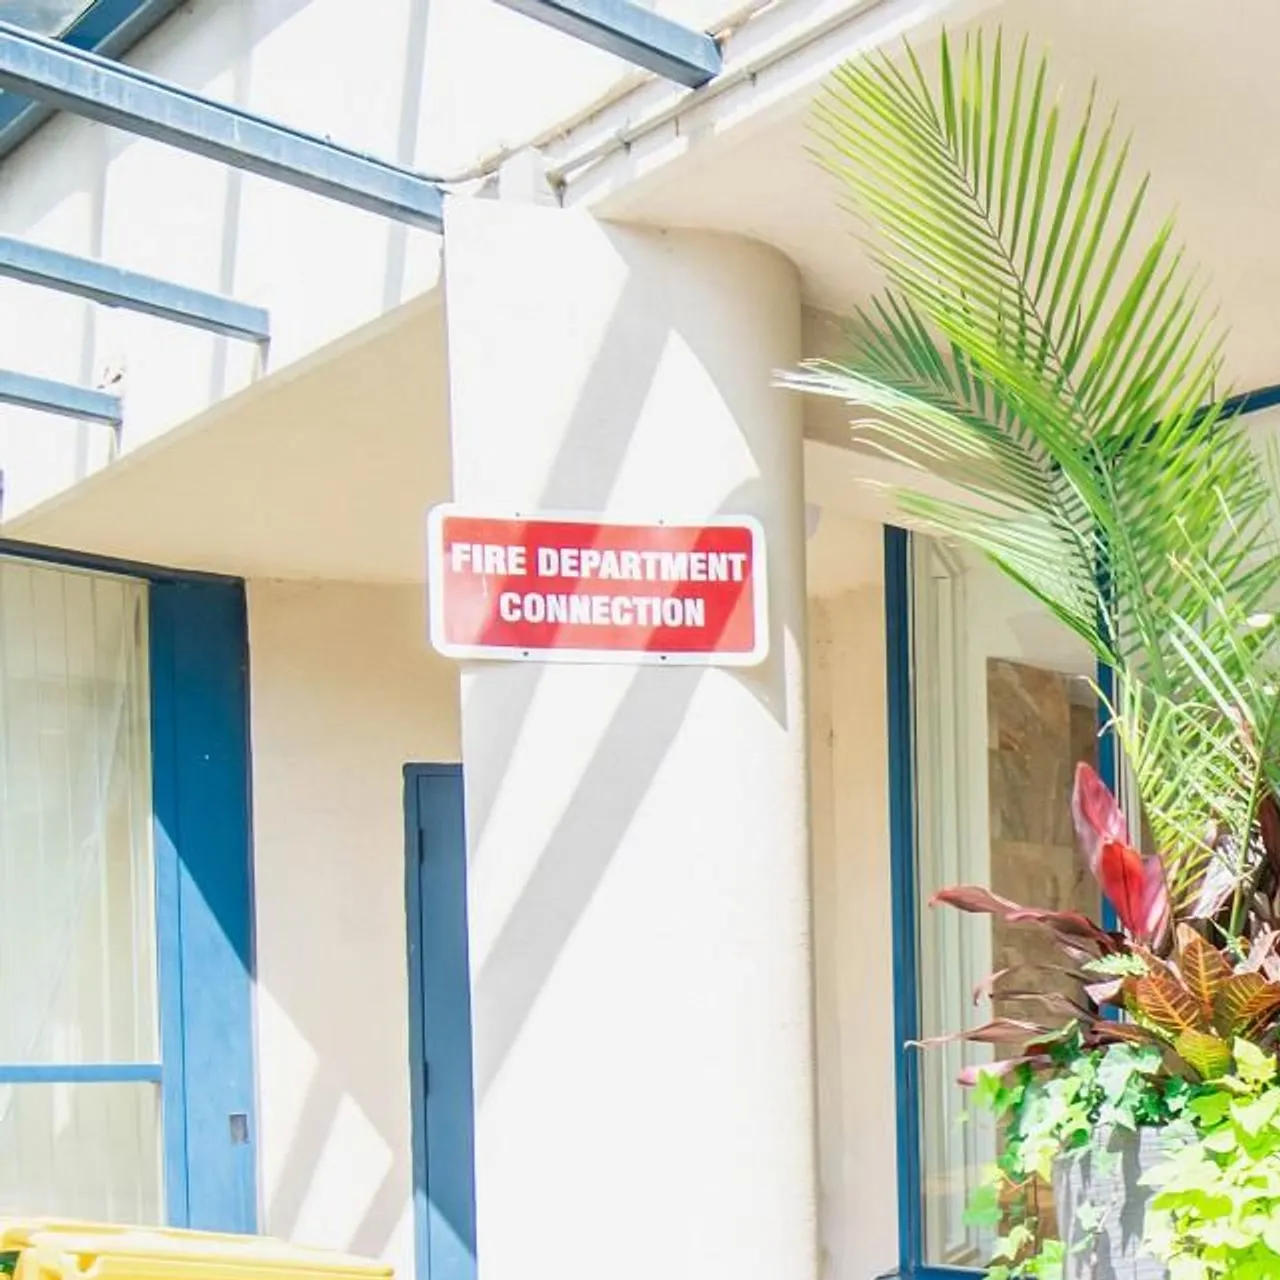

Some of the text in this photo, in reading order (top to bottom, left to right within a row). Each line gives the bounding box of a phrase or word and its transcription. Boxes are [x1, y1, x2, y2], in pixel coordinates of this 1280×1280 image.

[450, 542, 747, 582] FIRE DEPARTMENT
[499, 592, 706, 628] CONNECTION
